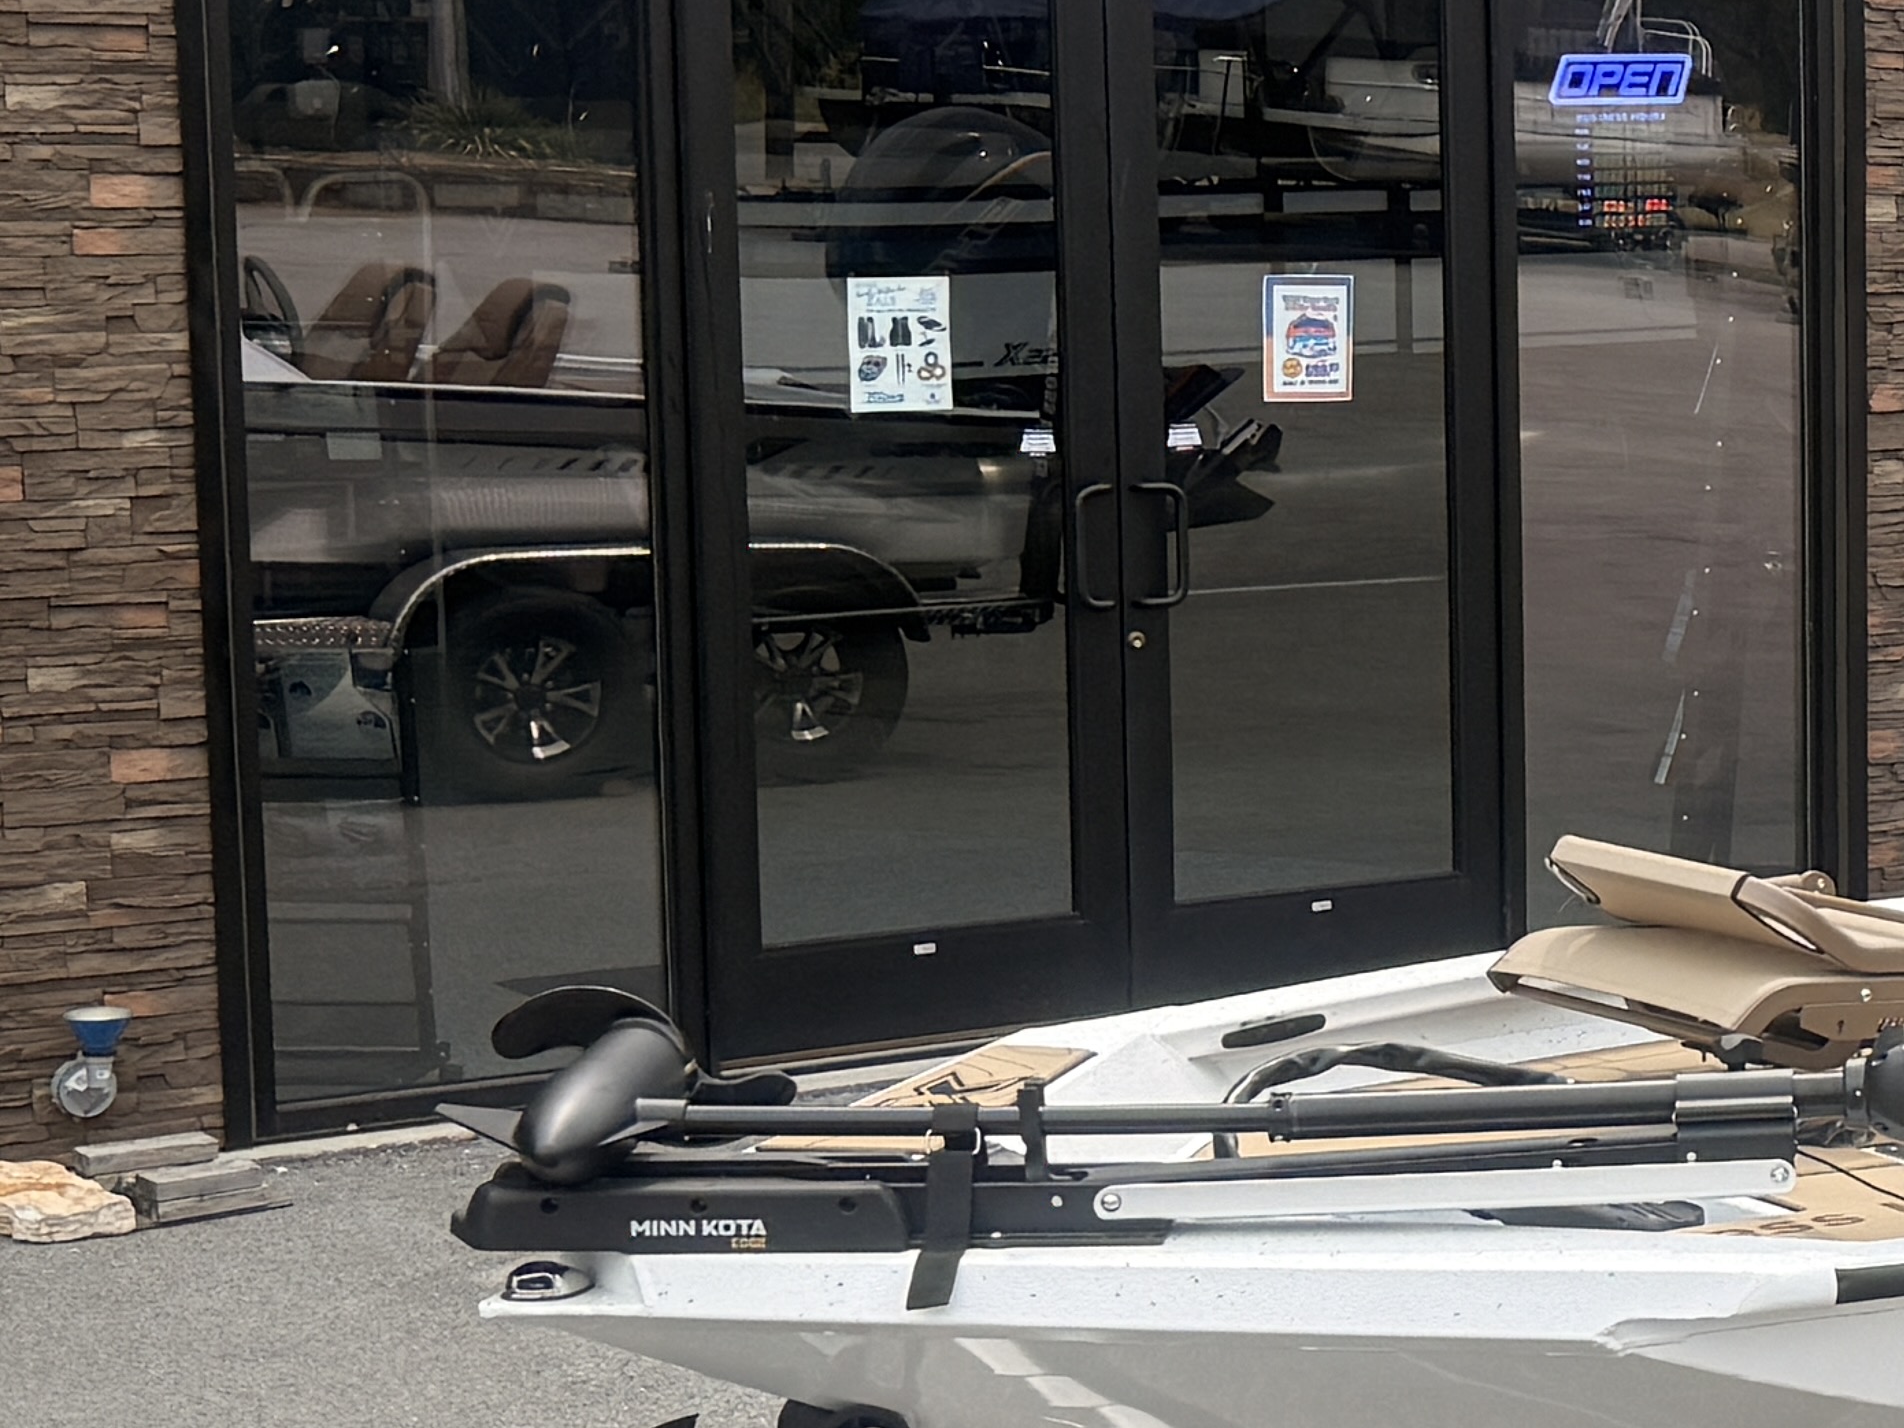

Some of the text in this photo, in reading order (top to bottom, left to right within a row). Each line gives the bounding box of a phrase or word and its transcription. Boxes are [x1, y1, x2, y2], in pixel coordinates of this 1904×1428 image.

[1559, 64, 1683, 97] OPEN
[630, 1218, 768, 1237] MINN KOTA
